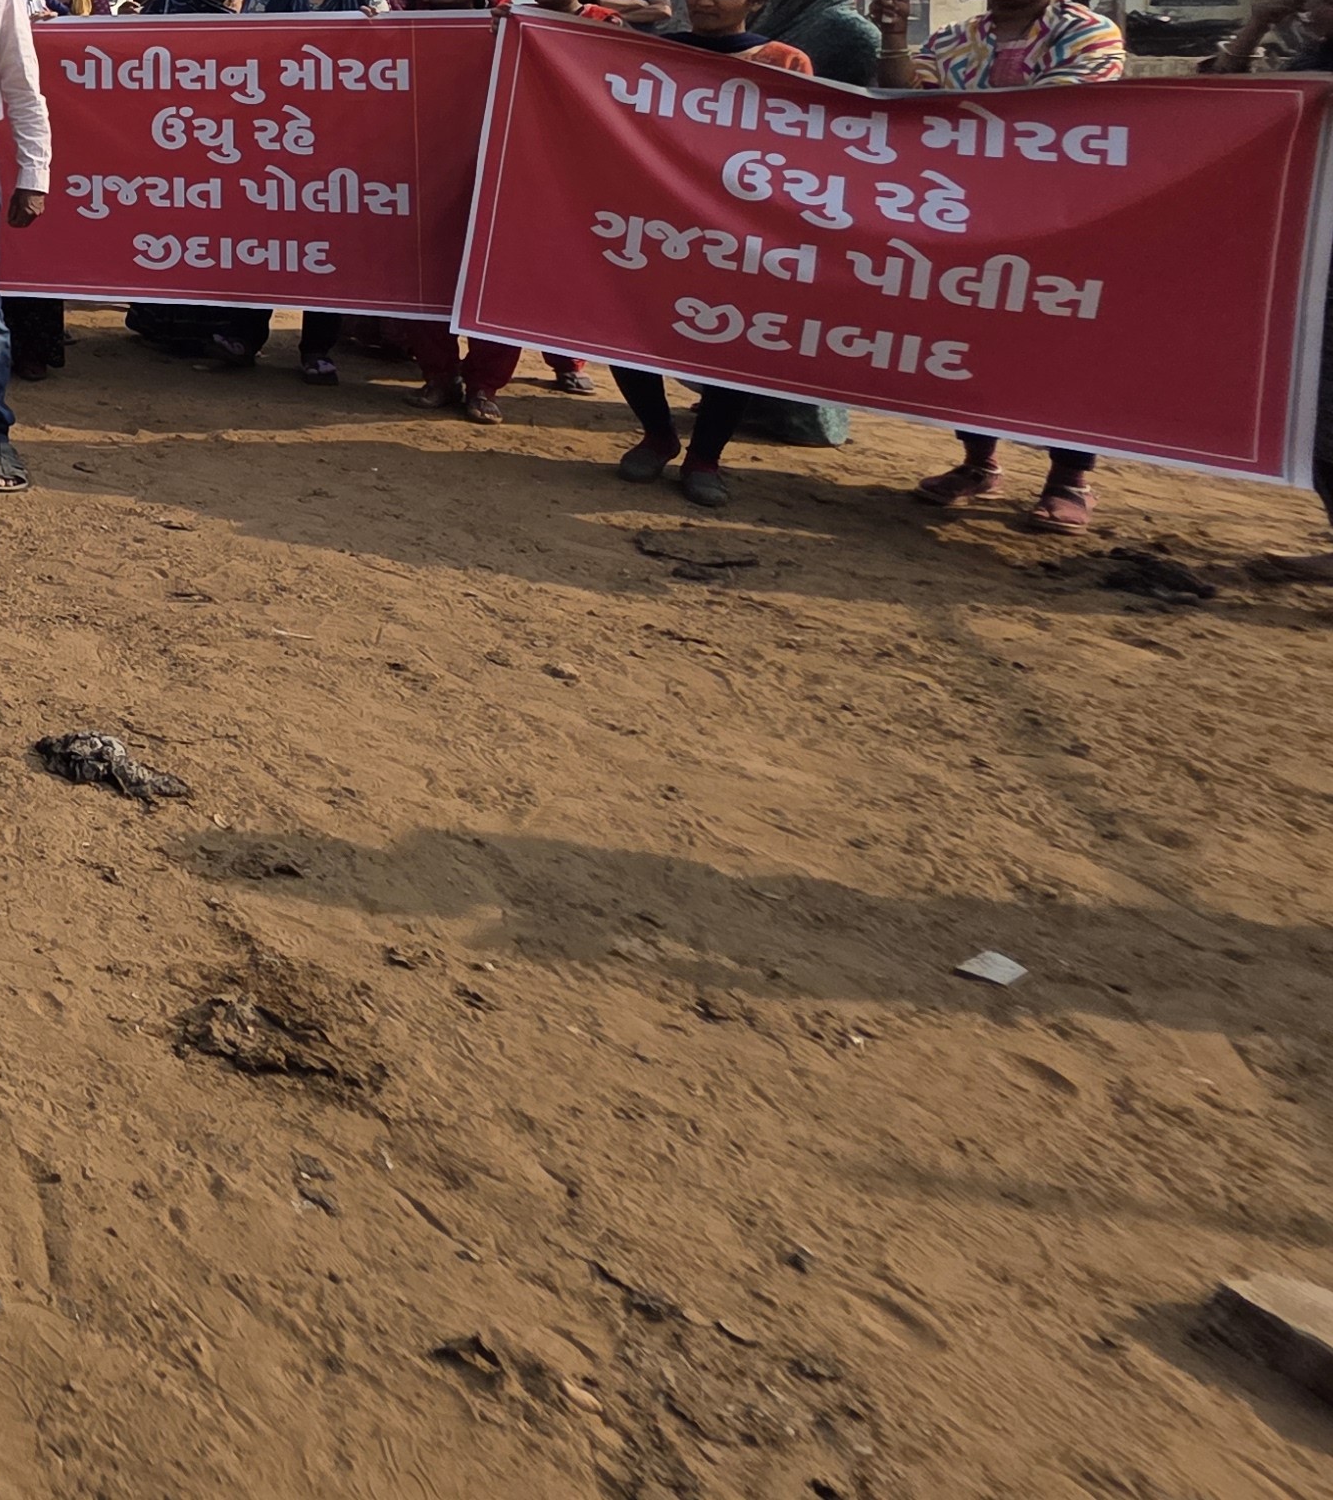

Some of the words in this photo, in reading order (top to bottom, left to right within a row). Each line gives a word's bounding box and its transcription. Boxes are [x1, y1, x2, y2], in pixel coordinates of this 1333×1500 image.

[61, 45, 266, 104] પોલીસનુ
[280, 44, 409, 91] મોરલ
[151, 106, 241, 164] ઉંચુ
[253, 104, 315, 155] રહે
[604, 62, 898, 166] પોલીસનુ
[921, 105, 1129, 166] મોરલ
[65, 175, 221, 219] ગુજરાત
[239, 165, 409, 215] પોલીસ
[722, 150, 853, 229] ઉંચુ
[875, 170, 970, 233] રહે
[133, 233, 336, 274] જીદાબાદ
[590, 210, 819, 284] ગુજરાત
[846, 238, 1104, 319] પોલીસ
[671, 297, 973, 380] જીદાબાદ
